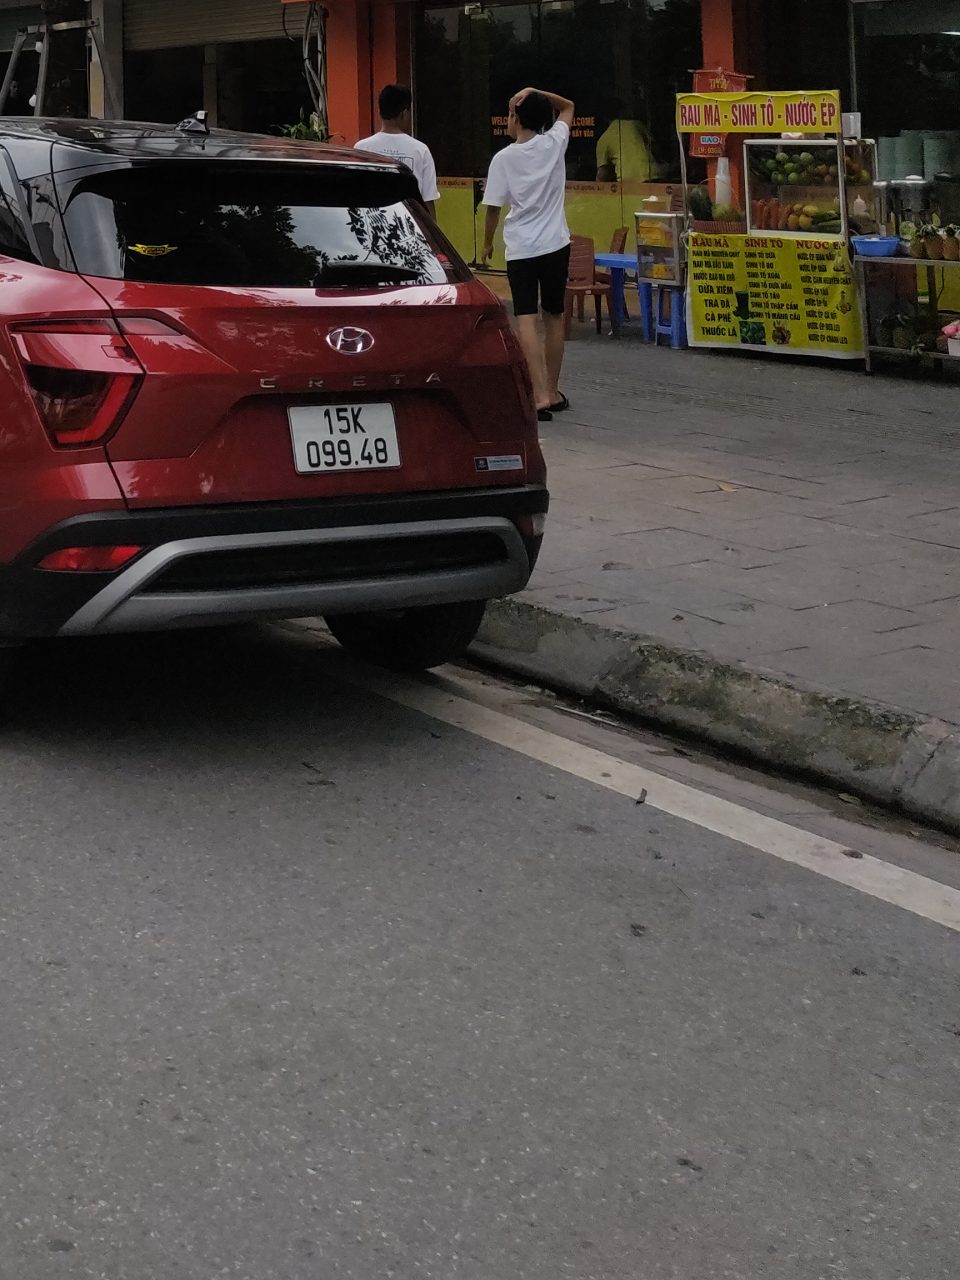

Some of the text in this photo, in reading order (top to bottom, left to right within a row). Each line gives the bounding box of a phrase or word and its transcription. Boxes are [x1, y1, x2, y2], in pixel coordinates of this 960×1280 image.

[680, 96, 836, 127] RAU MÁ SINH TỐ NƯỚC ÉP
[692, 237, 713, 247] RAU
[259, 371, 442, 389] CRETA
[323, 407, 366, 435] 15K
[306, 437, 389, 469] 099.48
